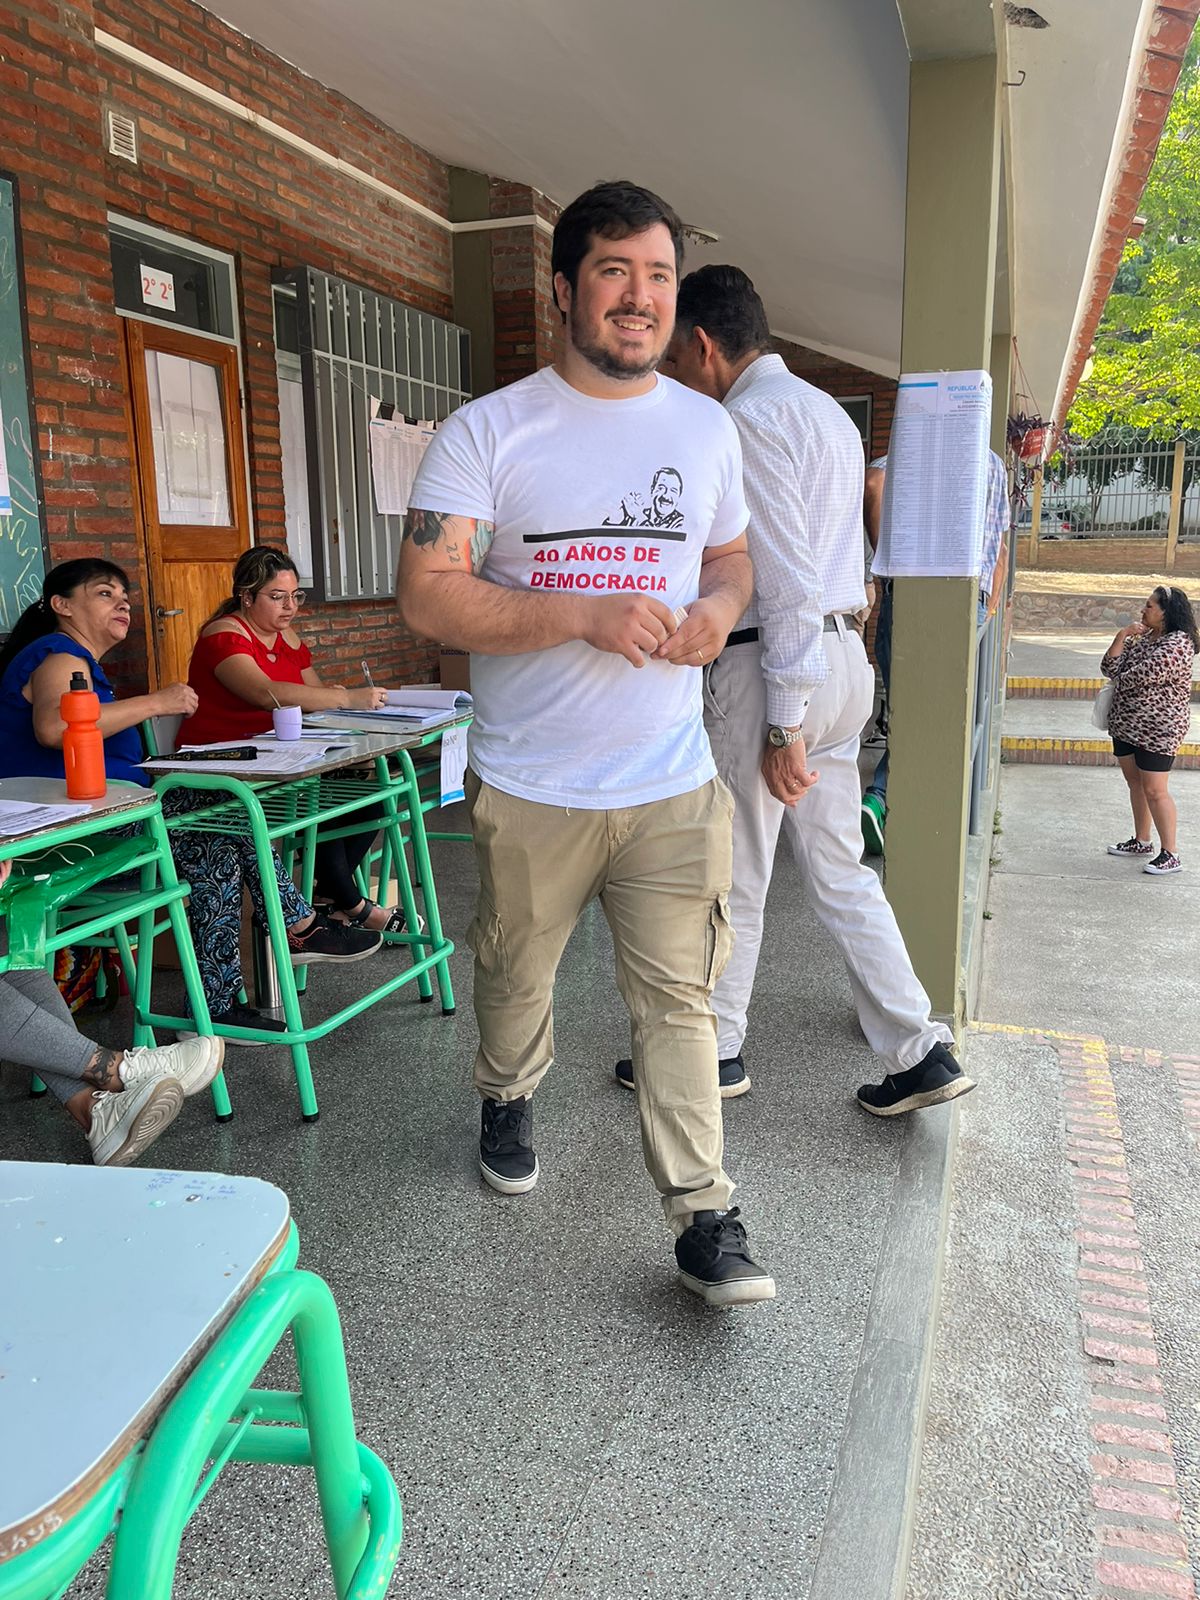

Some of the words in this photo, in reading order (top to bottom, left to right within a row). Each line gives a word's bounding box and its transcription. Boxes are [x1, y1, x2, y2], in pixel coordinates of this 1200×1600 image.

[533, 548, 559, 563] 40
[565, 543, 626, 562] AÑOS
[633, 546, 661, 563] DE
[530, 571, 667, 592] DEMOCRACIA
